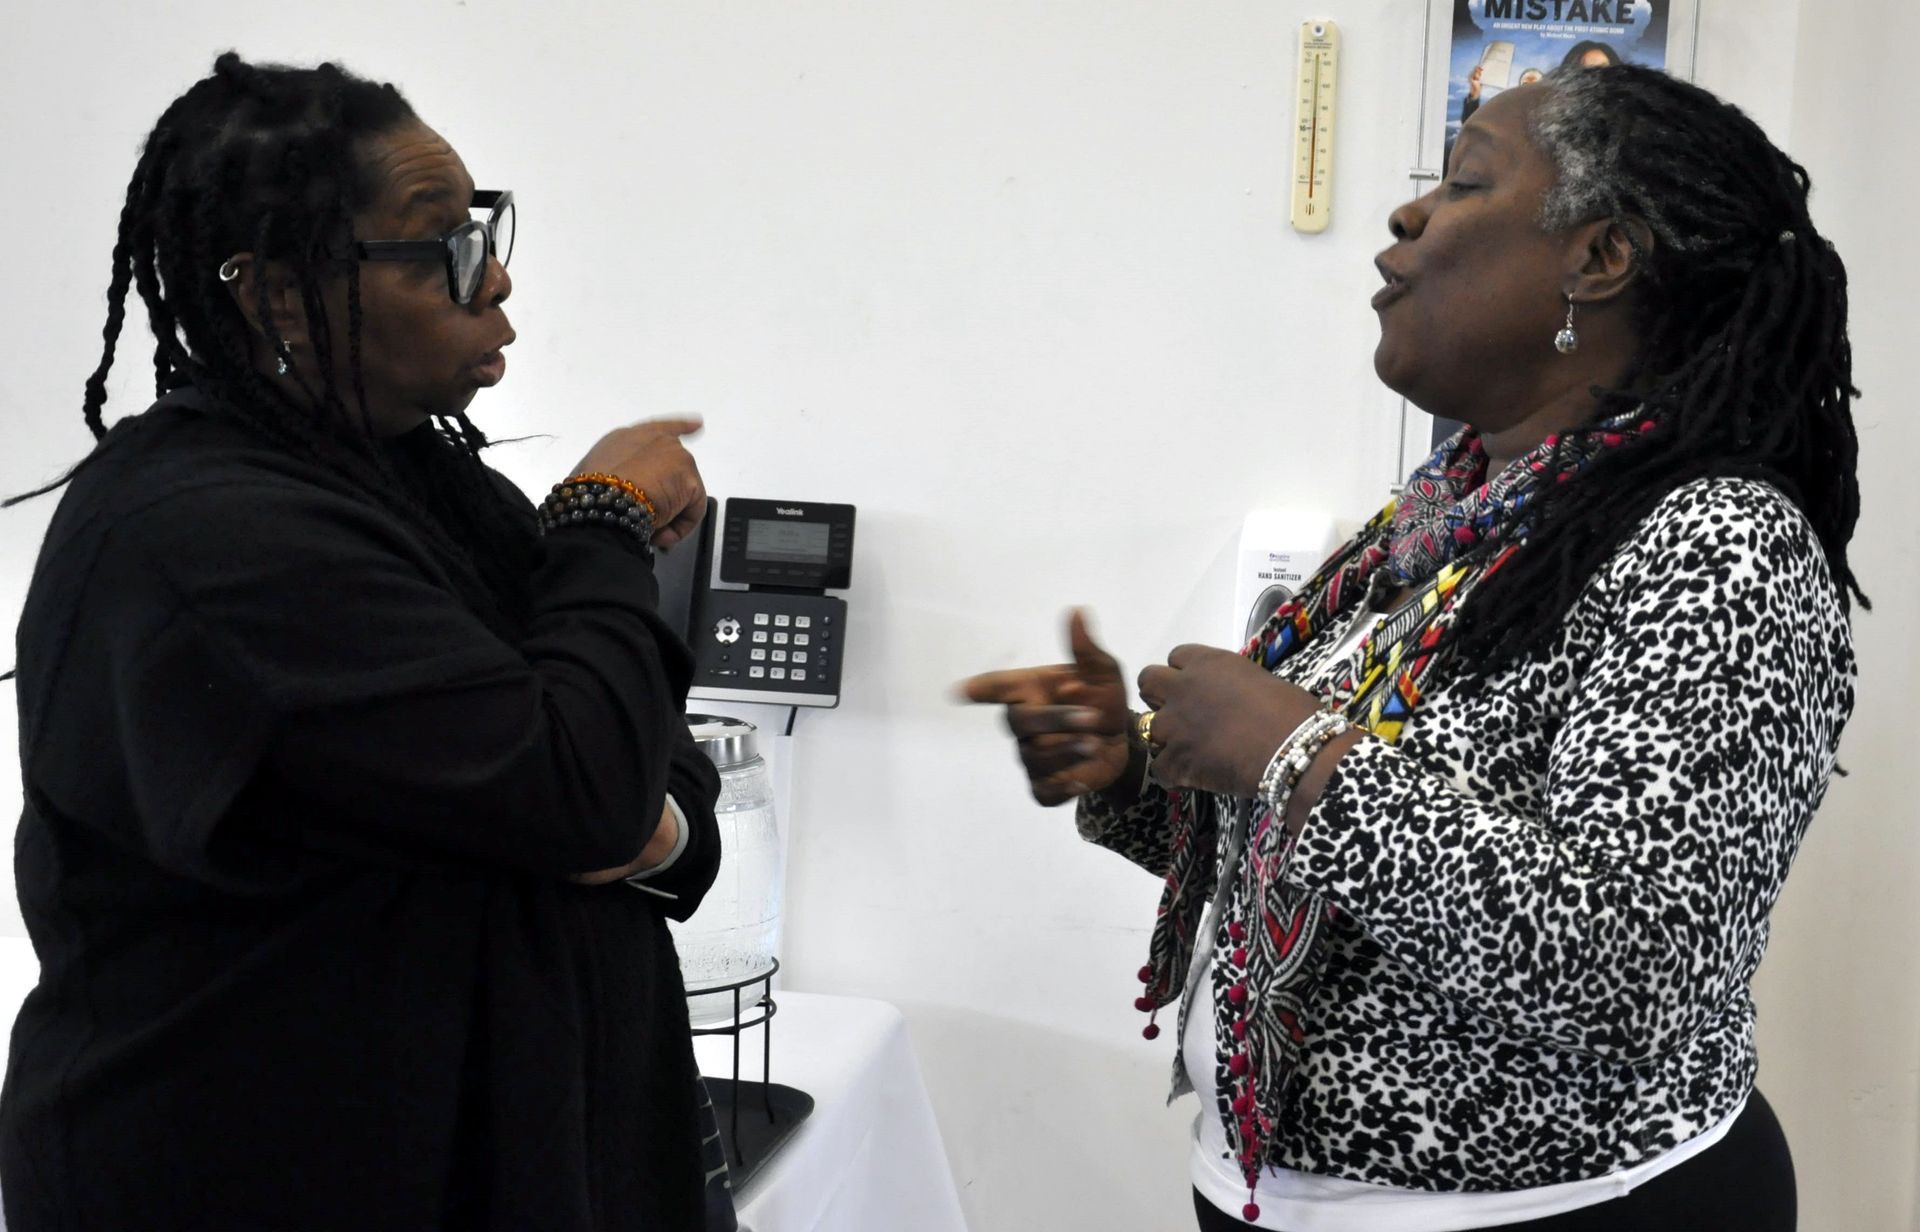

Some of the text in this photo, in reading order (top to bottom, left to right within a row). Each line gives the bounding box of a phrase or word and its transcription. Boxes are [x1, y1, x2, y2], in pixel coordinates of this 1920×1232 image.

[1484, 0, 1635, 24] MISTAKE
[1533, 23, 1546, 31] PLAY
[776, 507, 804, 516] Yealink
[1274, 573, 1301, 581] SANITIZER
